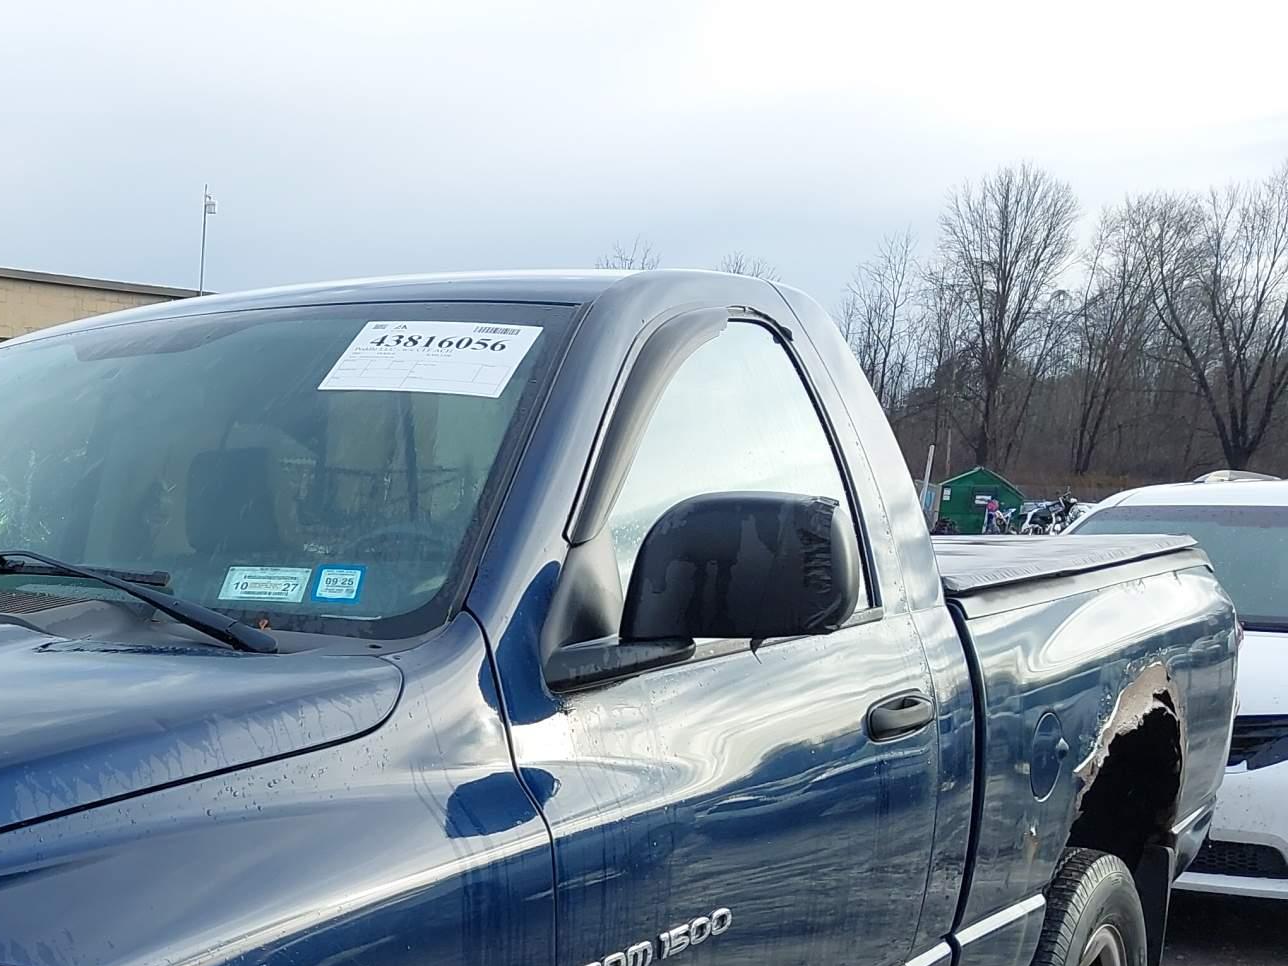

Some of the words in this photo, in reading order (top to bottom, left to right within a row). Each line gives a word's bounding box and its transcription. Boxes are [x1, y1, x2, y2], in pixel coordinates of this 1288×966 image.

[369, 334, 512, 352] 43816056
[232, 581, 249, 591] 10
[281, 583, 299, 592] 27
[340, 576, 354, 586] 25
[658, 907, 733, 960] 1500
